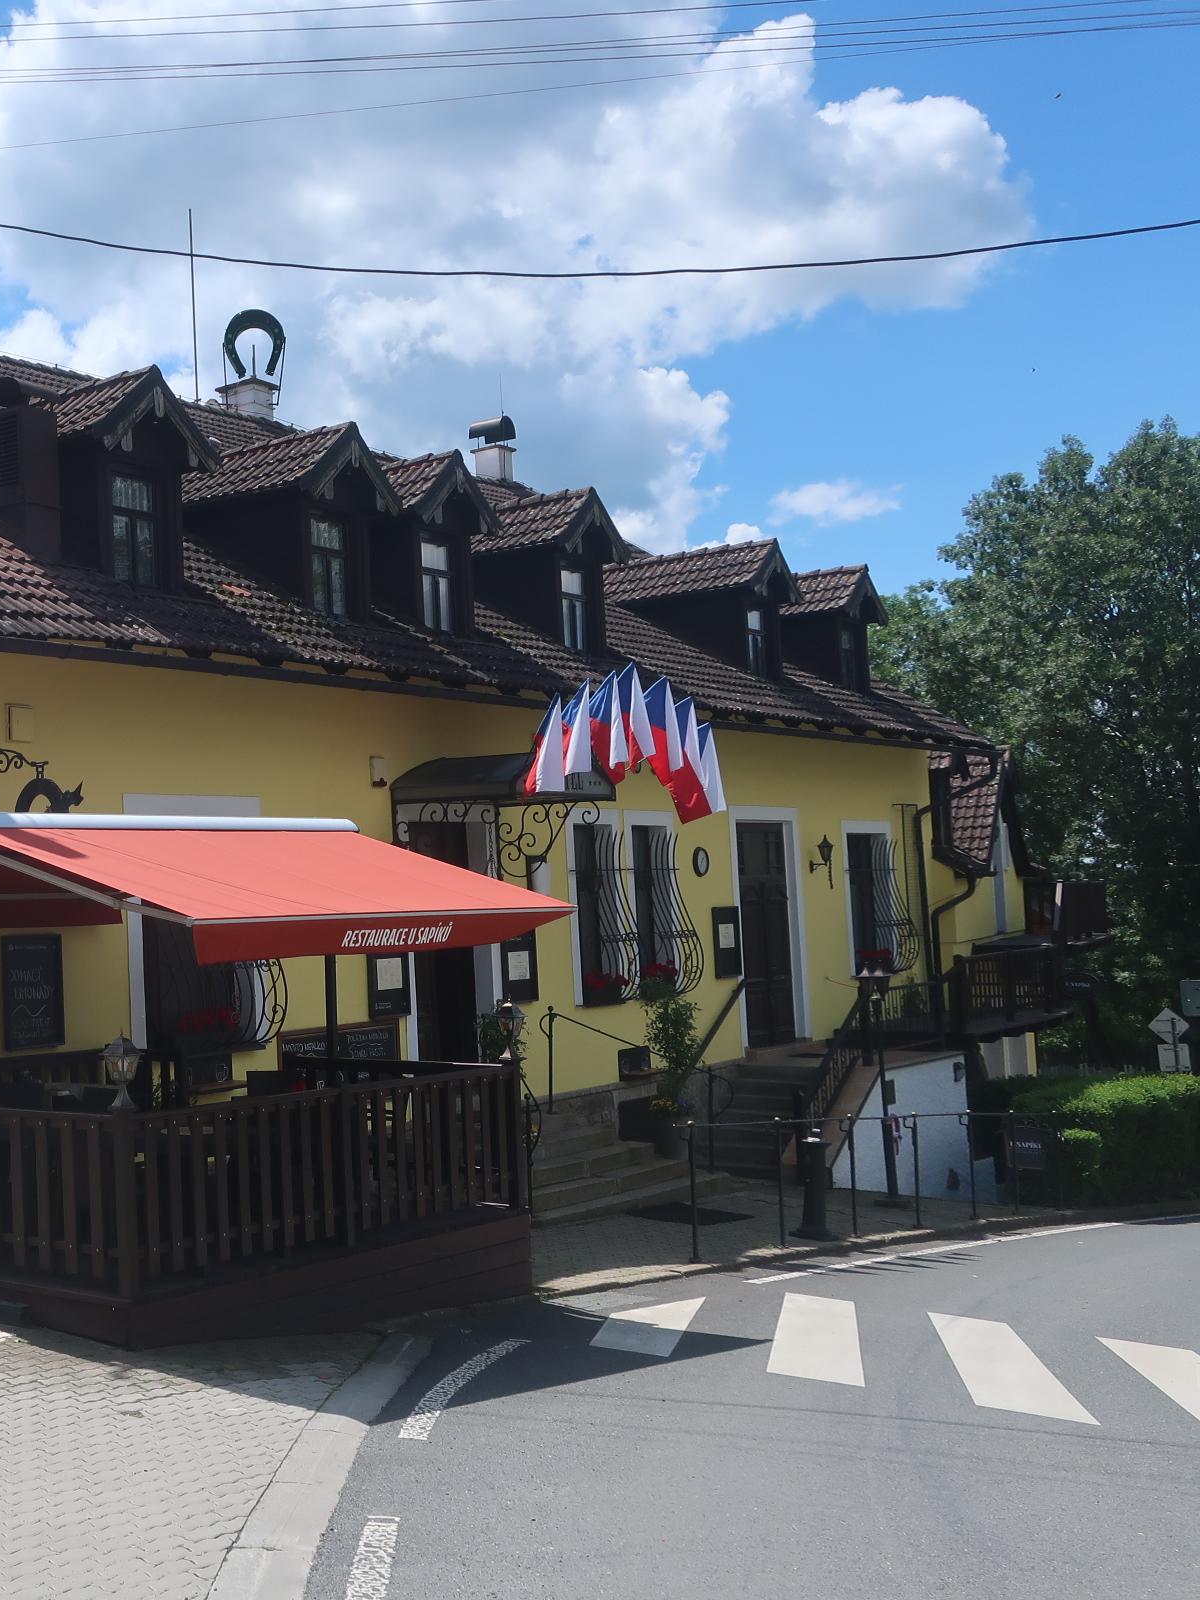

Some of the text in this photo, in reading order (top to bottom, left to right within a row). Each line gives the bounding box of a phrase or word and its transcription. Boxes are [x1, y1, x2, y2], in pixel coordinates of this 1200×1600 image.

[341, 921, 454, 948] RESTAURACE U SAPÍKŮ
